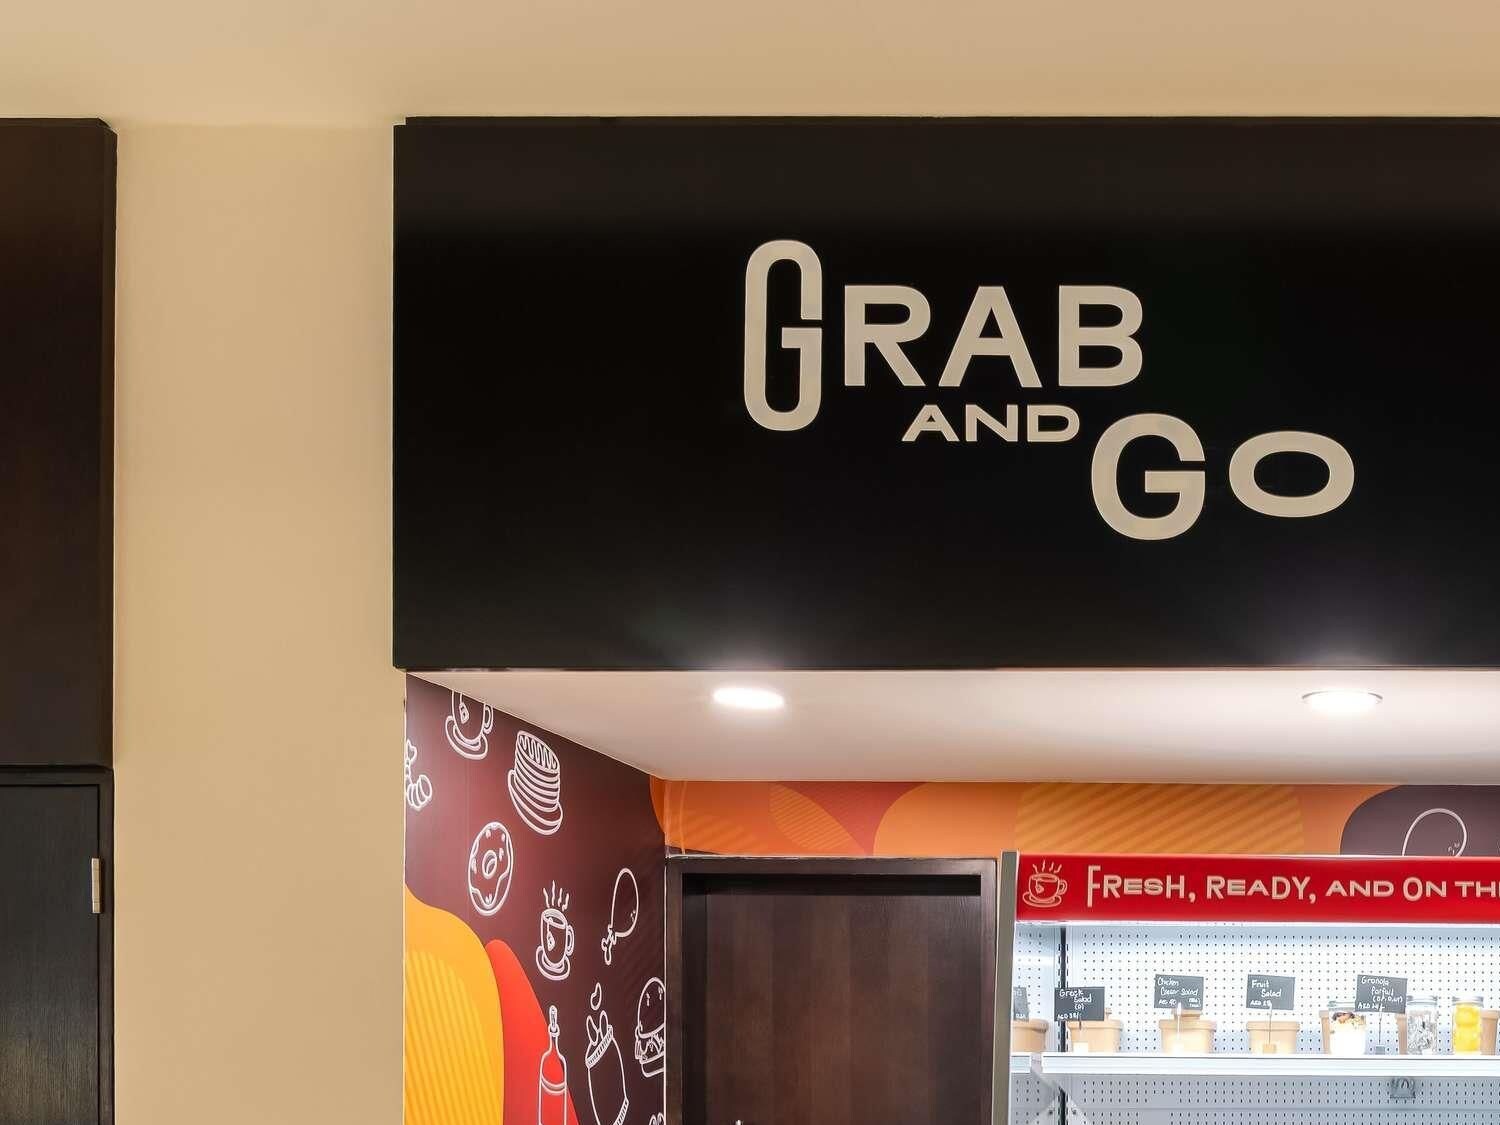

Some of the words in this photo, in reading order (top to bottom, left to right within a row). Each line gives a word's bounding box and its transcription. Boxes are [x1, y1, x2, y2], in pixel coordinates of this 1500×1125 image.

[743, 239, 1144, 431] GRAB
[901, 403, 1080, 443] AND
[1091, 412, 1355, 541] GO
[1086, 864, 1197, 908] FRESH,
[1206, 874, 1317, 905] READY,
[1324, 879, 1395, 898] AND
[1402, 876, 1447, 902] ON
[1251, 979, 1270, 989] Fruit
[1261, 988, 1282, 998] Salad
